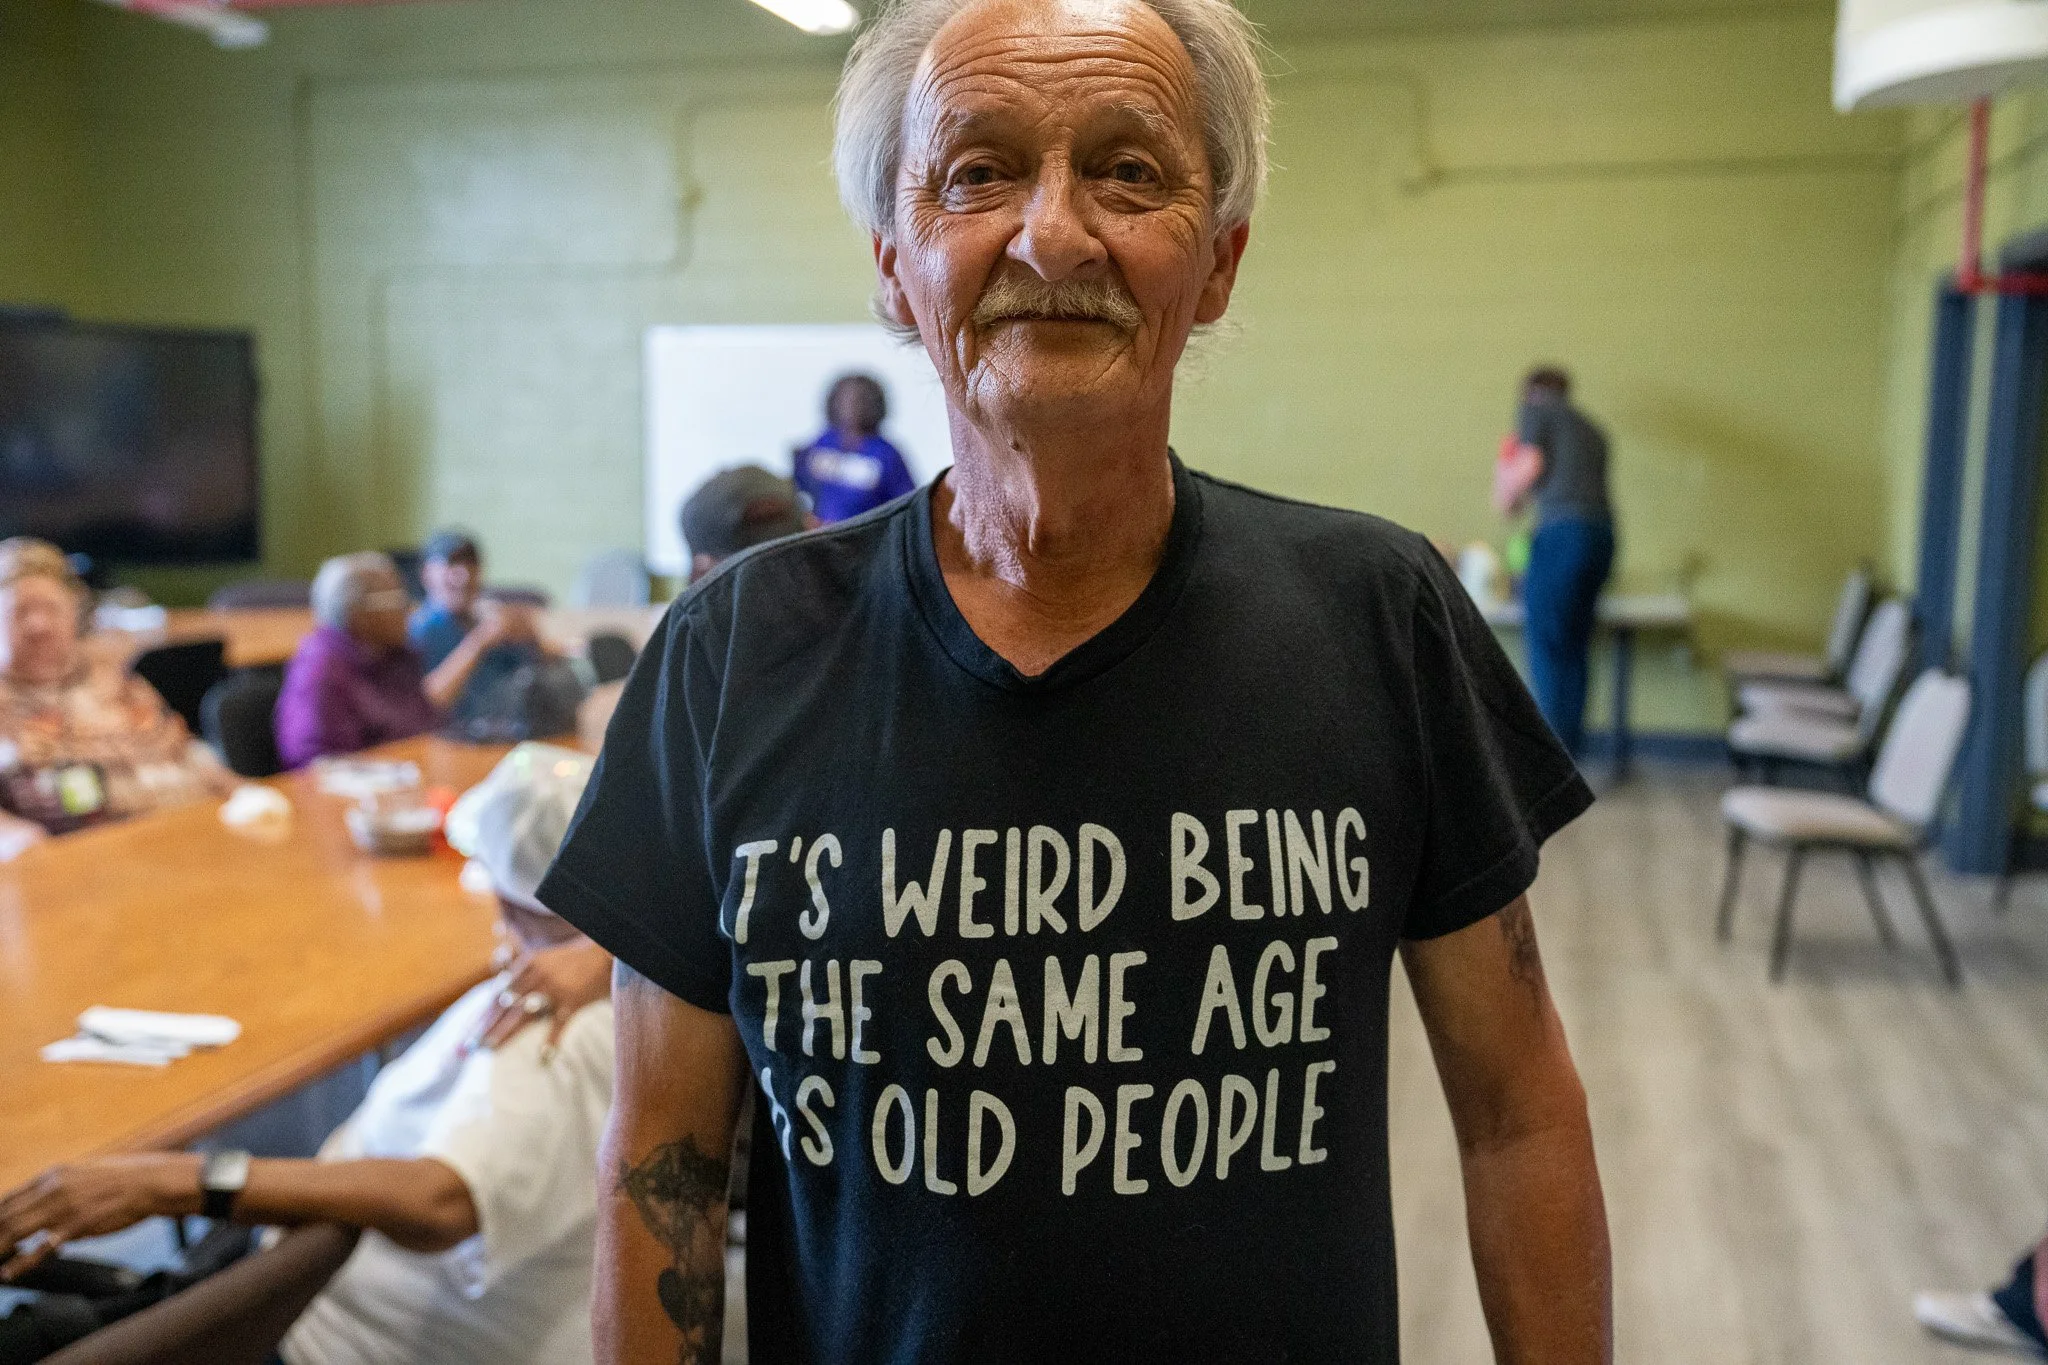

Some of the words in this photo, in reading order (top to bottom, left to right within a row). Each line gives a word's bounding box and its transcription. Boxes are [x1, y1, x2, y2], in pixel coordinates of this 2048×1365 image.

[718, 832, 844, 944] T'S
[881, 822, 1128, 939] WEIRD
[1169, 807, 1370, 922] BEING
[746, 958, 883, 1065] THE
[926, 950, 1149, 1068] SAME
[1190, 935, 1340, 1056] AGE
[871, 1083, 1017, 1197] OLD
[1060, 1059, 1337, 1196] PEOPLE
